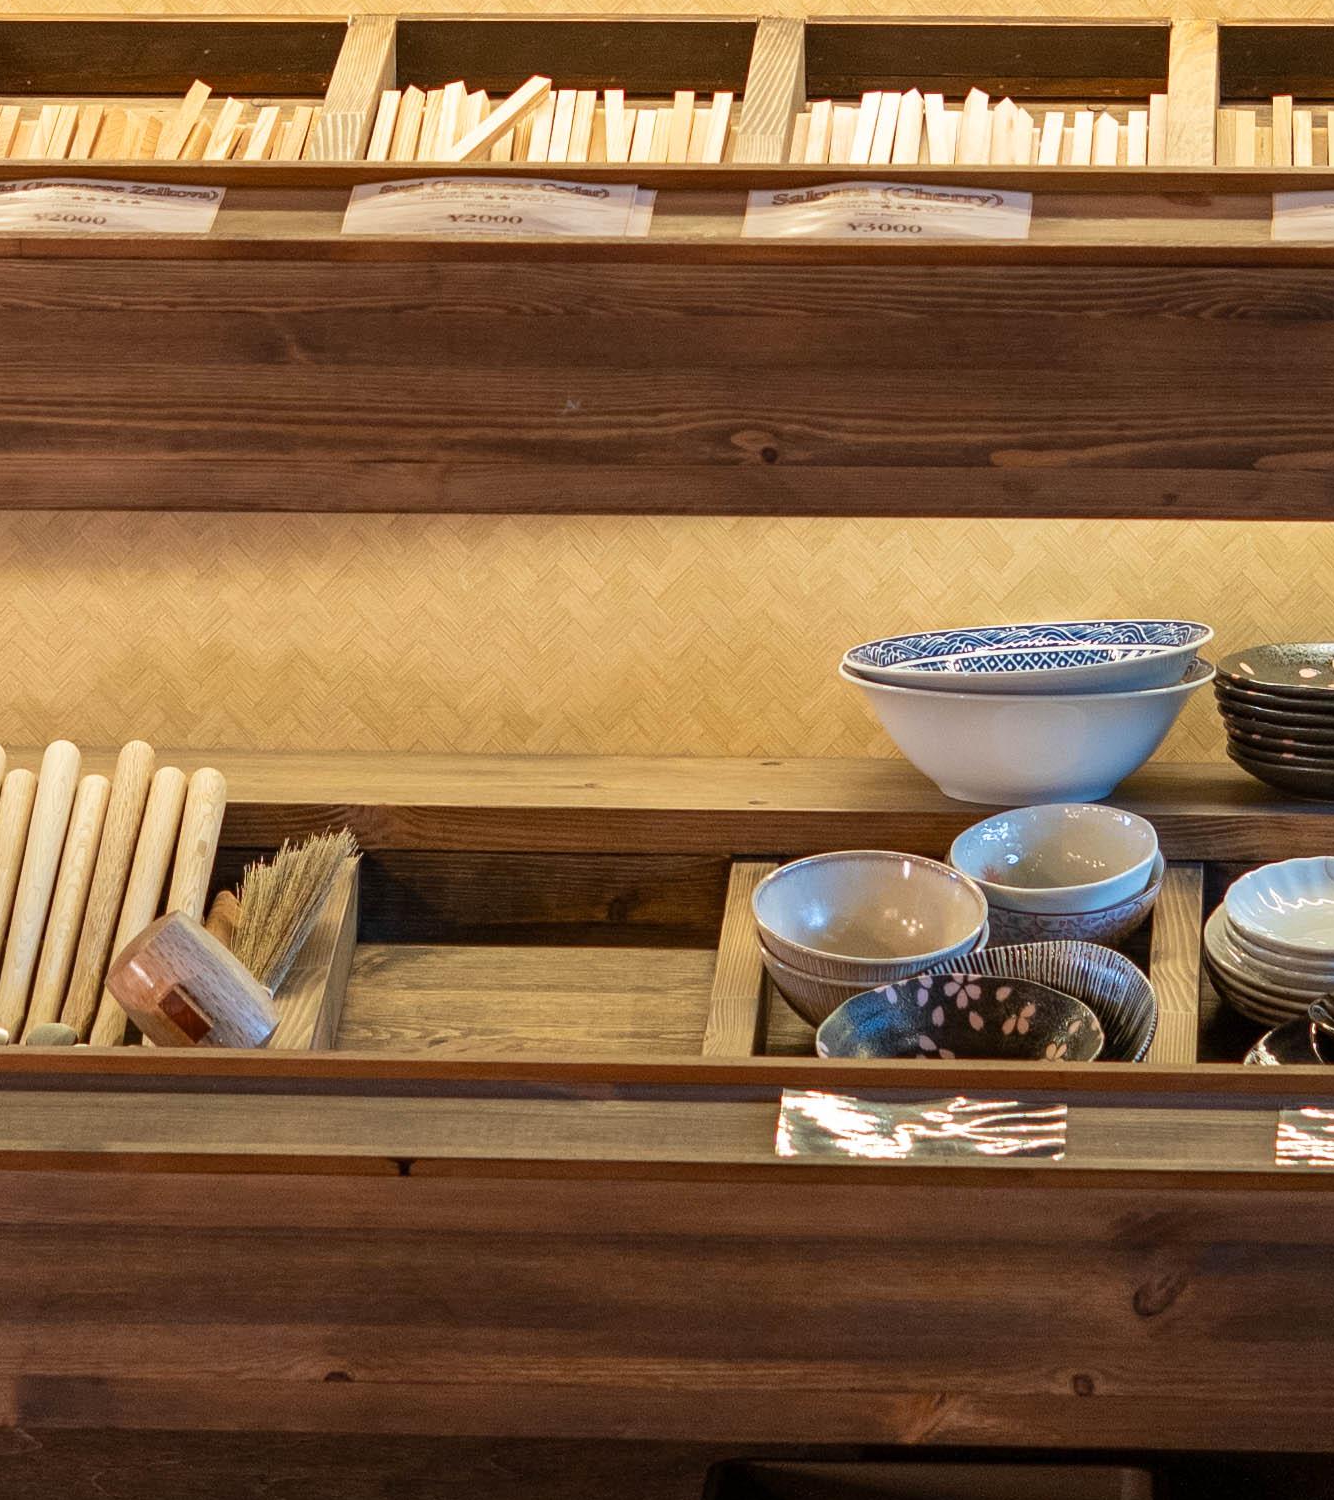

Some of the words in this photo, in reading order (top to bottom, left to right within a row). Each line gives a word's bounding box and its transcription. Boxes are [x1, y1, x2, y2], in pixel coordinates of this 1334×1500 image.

[771, 186, 870, 206] Sakura
[880, 185, 1004, 207] (Cherry)
[33, 211, 107, 226] ¥2000
[447, 213, 523, 226] ¥2000
[845, 221, 923, 235] ¥3000
